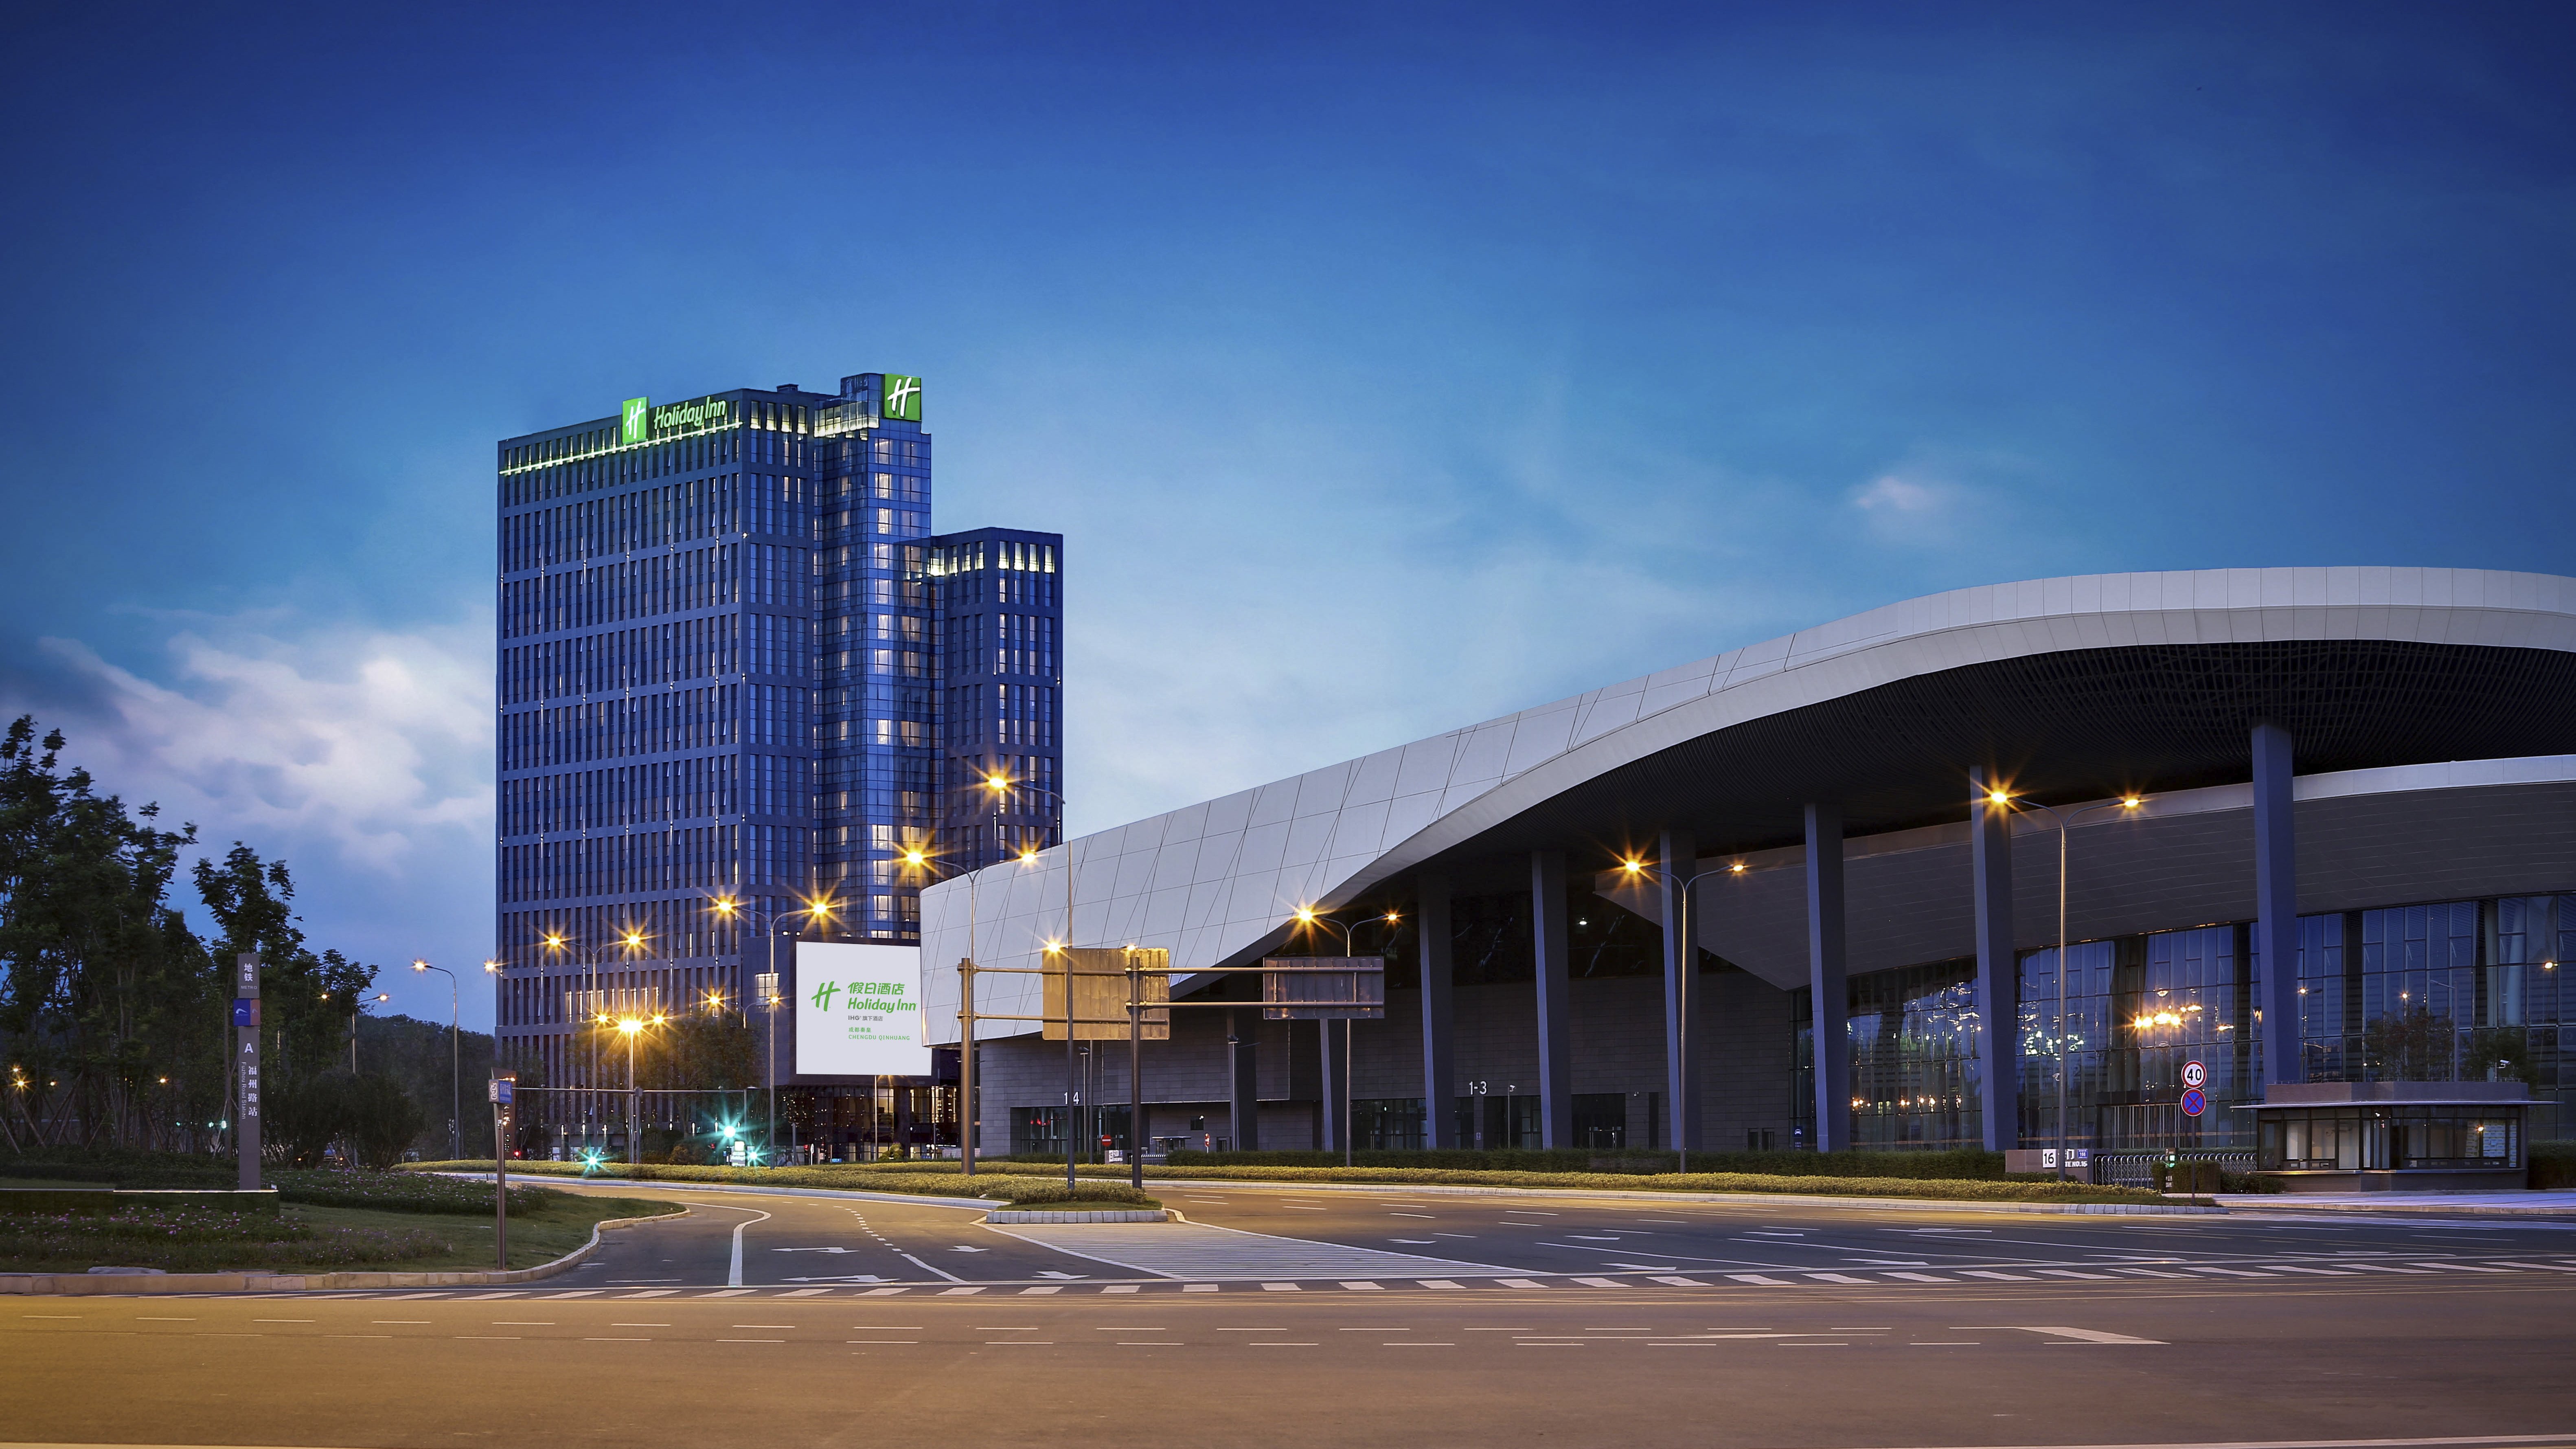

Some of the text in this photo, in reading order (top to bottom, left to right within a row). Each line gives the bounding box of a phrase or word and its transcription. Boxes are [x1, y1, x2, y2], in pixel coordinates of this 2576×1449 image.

[654, 396, 726, 429] Holiday Inn
[244, 963, 253, 981] 地铁
[848, 982, 905, 995] 假日酒店
[848, 997, 916, 1013] Holiday Inn
[244, 1043, 254, 1053] A
[2187, 1069, 2202, 1080] 40
[248, 1066, 258, 1117] 福州路站
[1469, 1081, 1487, 1095] 1-3
[2044, 1153, 2054, 1164] 16
